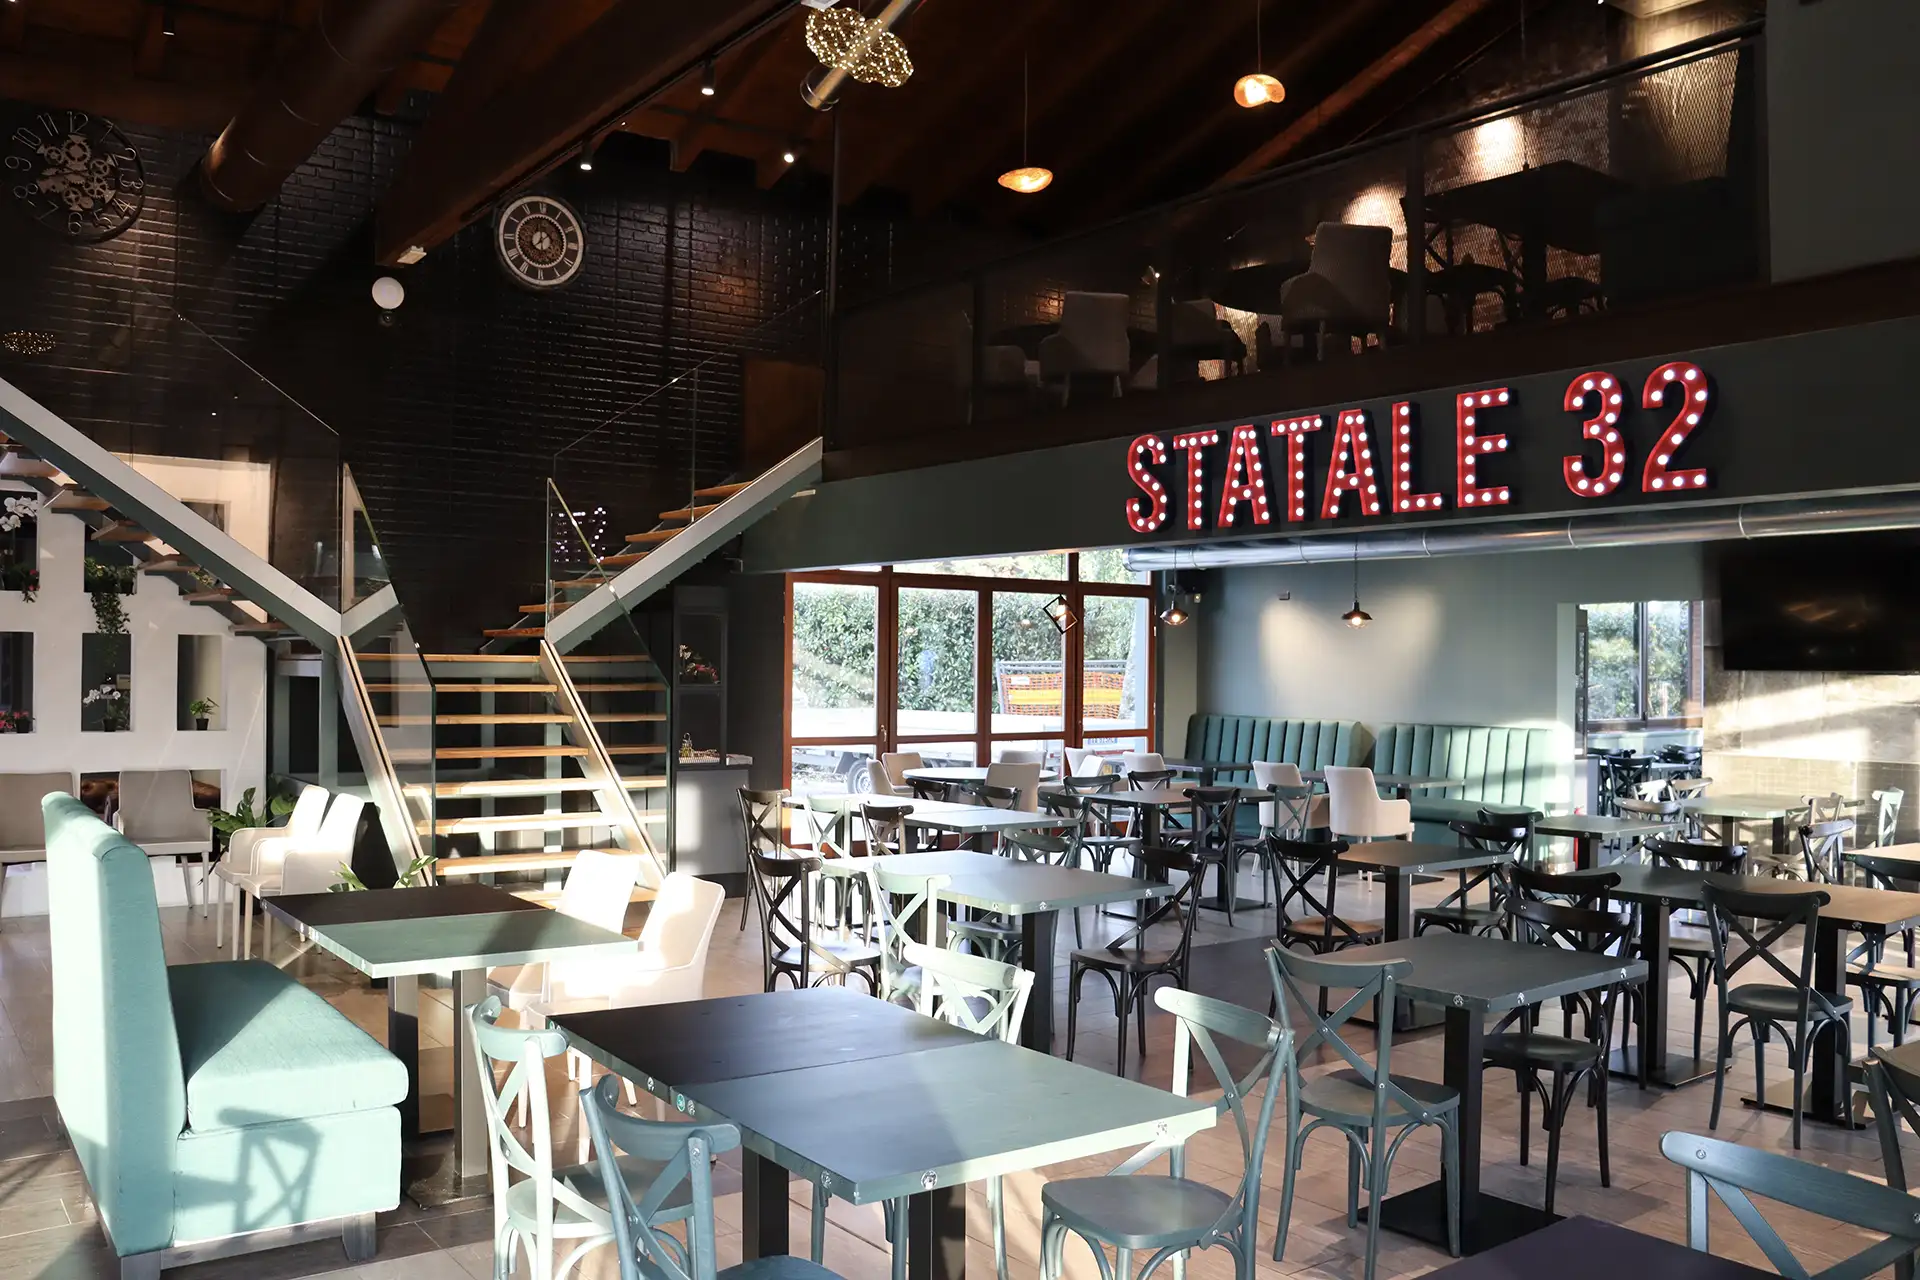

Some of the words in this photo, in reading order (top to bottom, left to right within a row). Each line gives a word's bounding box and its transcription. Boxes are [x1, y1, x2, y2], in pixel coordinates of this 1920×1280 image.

[66, 110, 89, 134] 12
[12, 127, 42, 151] 10
[4, 155, 32, 172] 9
[1126, 387, 1509, 533] STATALE
[1563, 361, 1708, 497] 32
